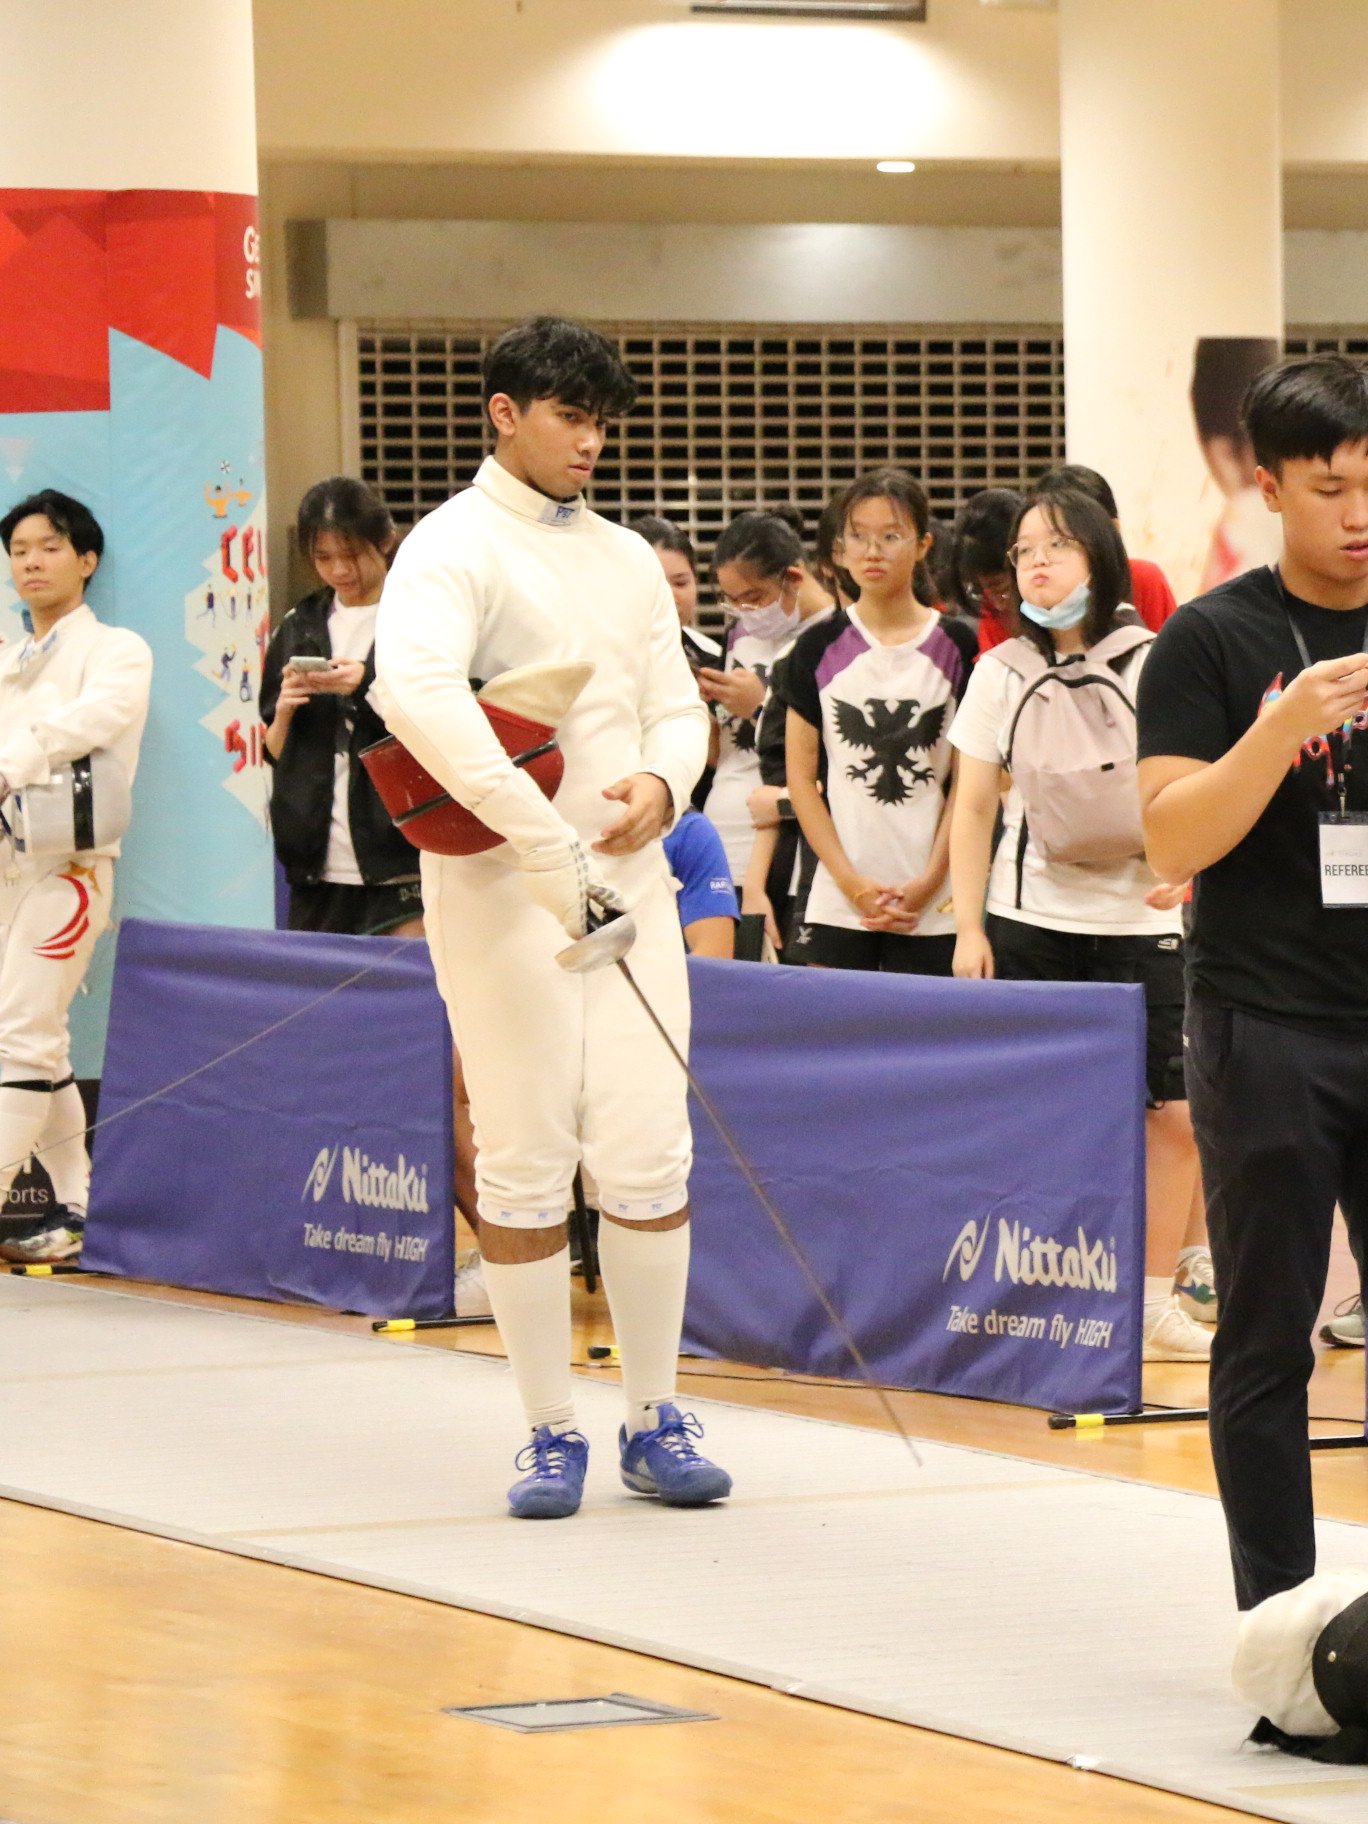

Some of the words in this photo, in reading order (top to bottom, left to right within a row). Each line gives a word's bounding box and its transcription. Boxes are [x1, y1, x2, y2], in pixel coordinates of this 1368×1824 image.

[342, 1145, 430, 1214] Nittaku
[304, 1222, 332, 1250] Take
[334, 1226, 375, 1255] dream
[376, 1231, 392, 1263] fly
[394, 1235, 430, 1262] HIGH
[994, 1217, 1117, 1293] Nittaku
[946, 1305, 978, 1334] Take
[984, 1309, 1046, 1339] dream
[1049, 1313, 1074, 1349] fly
[1074, 1318, 1113, 1349] HIGH
